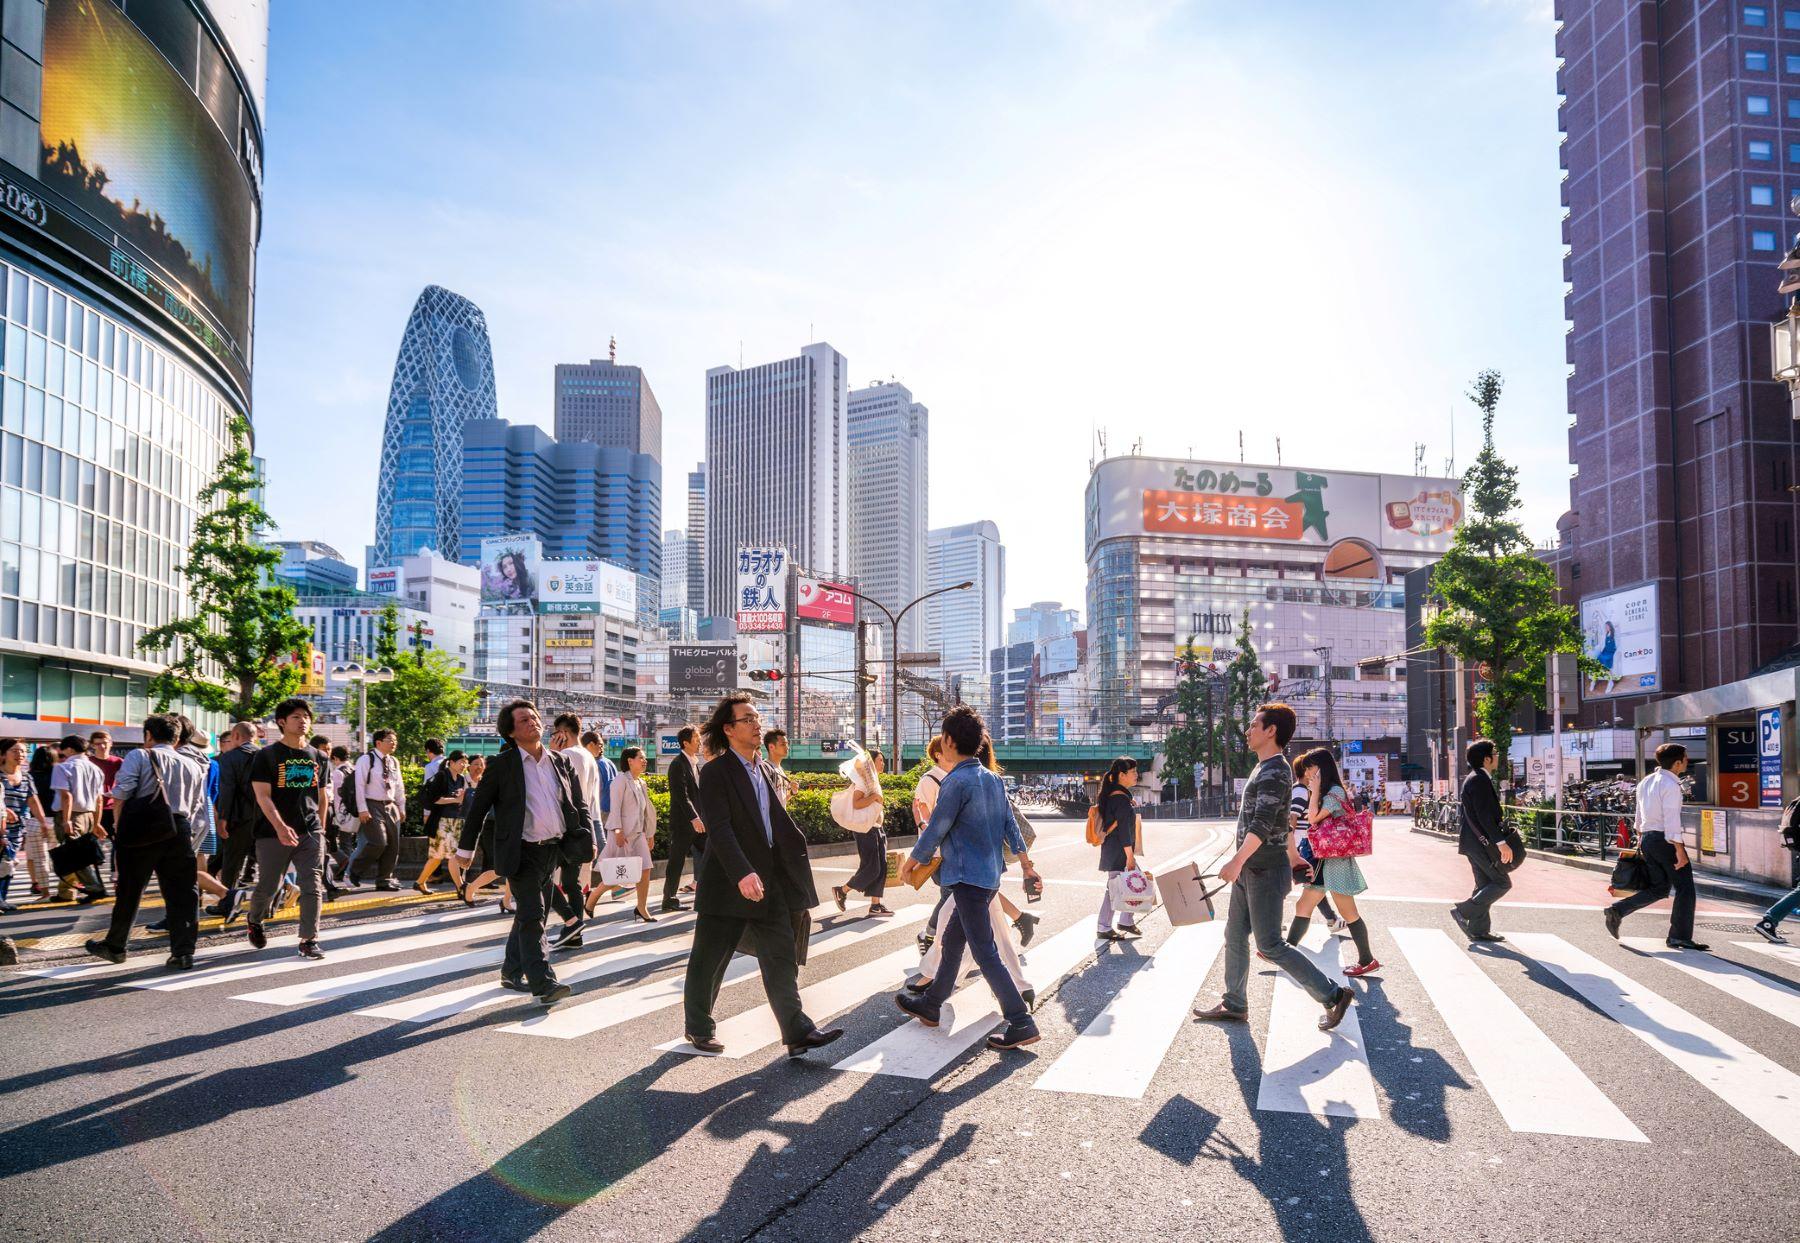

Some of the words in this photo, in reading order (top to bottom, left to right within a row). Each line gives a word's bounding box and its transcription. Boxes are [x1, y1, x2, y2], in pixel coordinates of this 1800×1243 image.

[1174, 467, 1273, 496] たのめーる
[1157, 500, 1291, 529] 大塚商会
[739, 549, 784, 574] カラオケ
[565, 582, 593, 591] 英会話
[756, 573, 767, 588] の
[742, 586, 780, 609] 鉄人
[825, 591, 852, 605] アコム
[1626, 599, 1647, 608] coen
[547, 602, 578, 611] 新宿本校
[822, 610, 832, 618] 2F
[685, 665, 713, 679] global
[1762, 720, 1771, 752] P
[1732, 781, 1749, 802] 3
